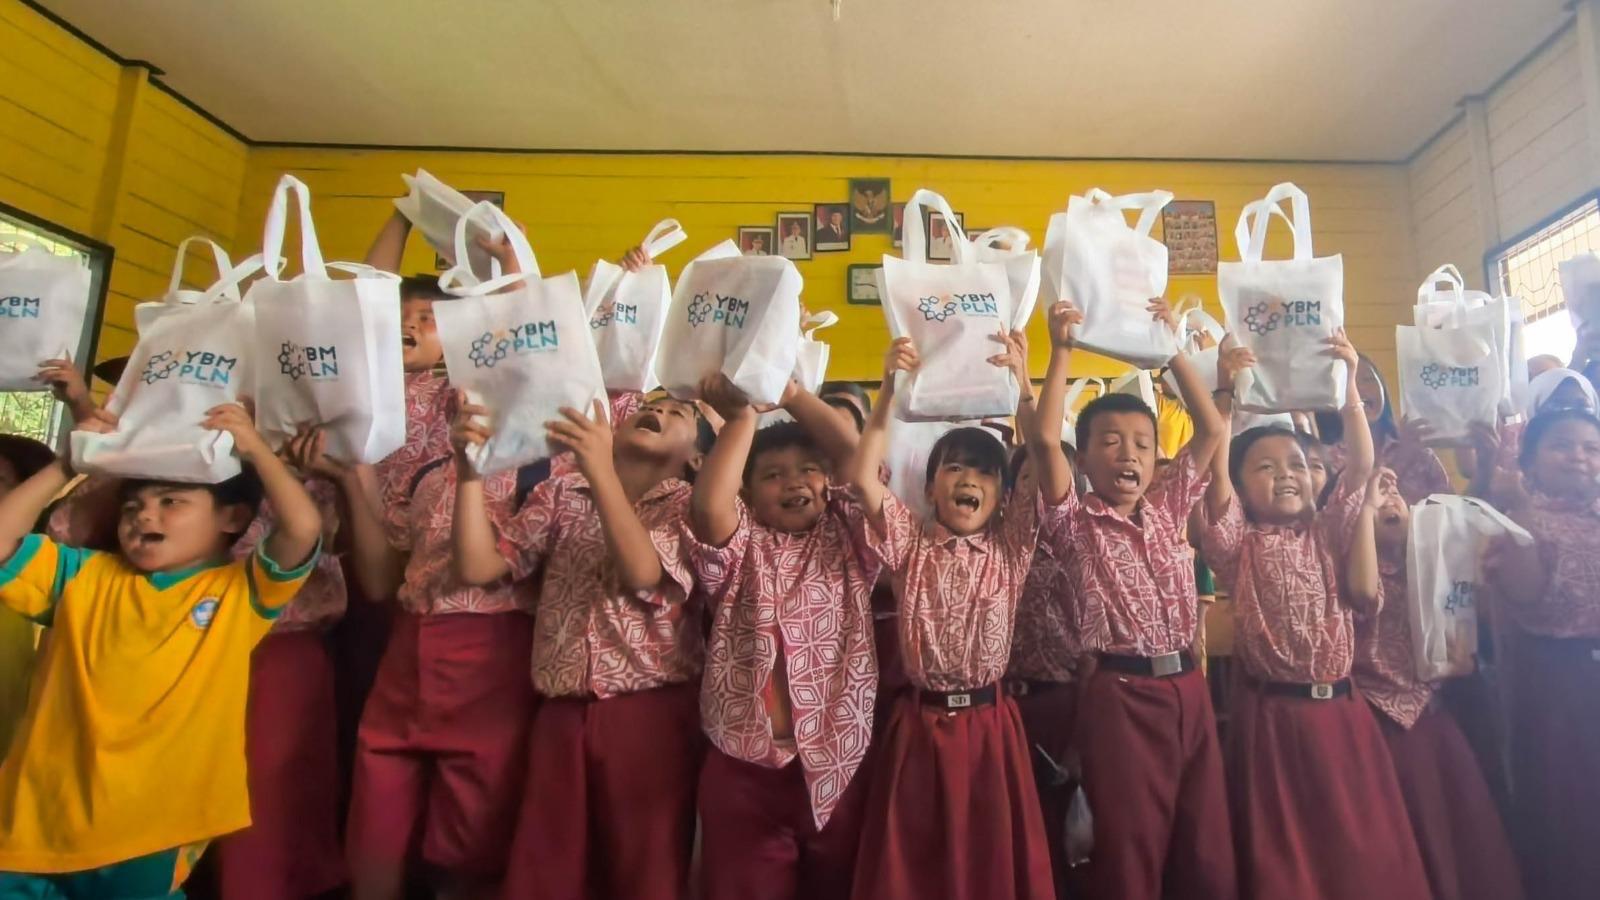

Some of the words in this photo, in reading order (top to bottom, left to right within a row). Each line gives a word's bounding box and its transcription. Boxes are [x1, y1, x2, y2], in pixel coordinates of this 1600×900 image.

[715, 294, 749, 314] YBM
[953, 292, 995, 302] YBM
[612, 301, 637, 315] BM
[961, 302, 998, 313] PLN
[1280, 300, 1321, 313] YBM
[615, 311, 637, 324] LN
[713, 310, 745, 328] PLN
[1283, 314, 1321, 327] PLN
[508, 319, 556, 338] YBM
[513, 335, 558, 352] PLN
[302, 345, 336, 361] BM
[186, 351, 237, 370] YBM
[179, 364, 229, 384] PLN
[308, 361, 338, 376] LN
[1448, 366, 1479, 377] YBM
[1450, 376, 1479, 386] PLN
[1452, 580, 1473, 594] YB
